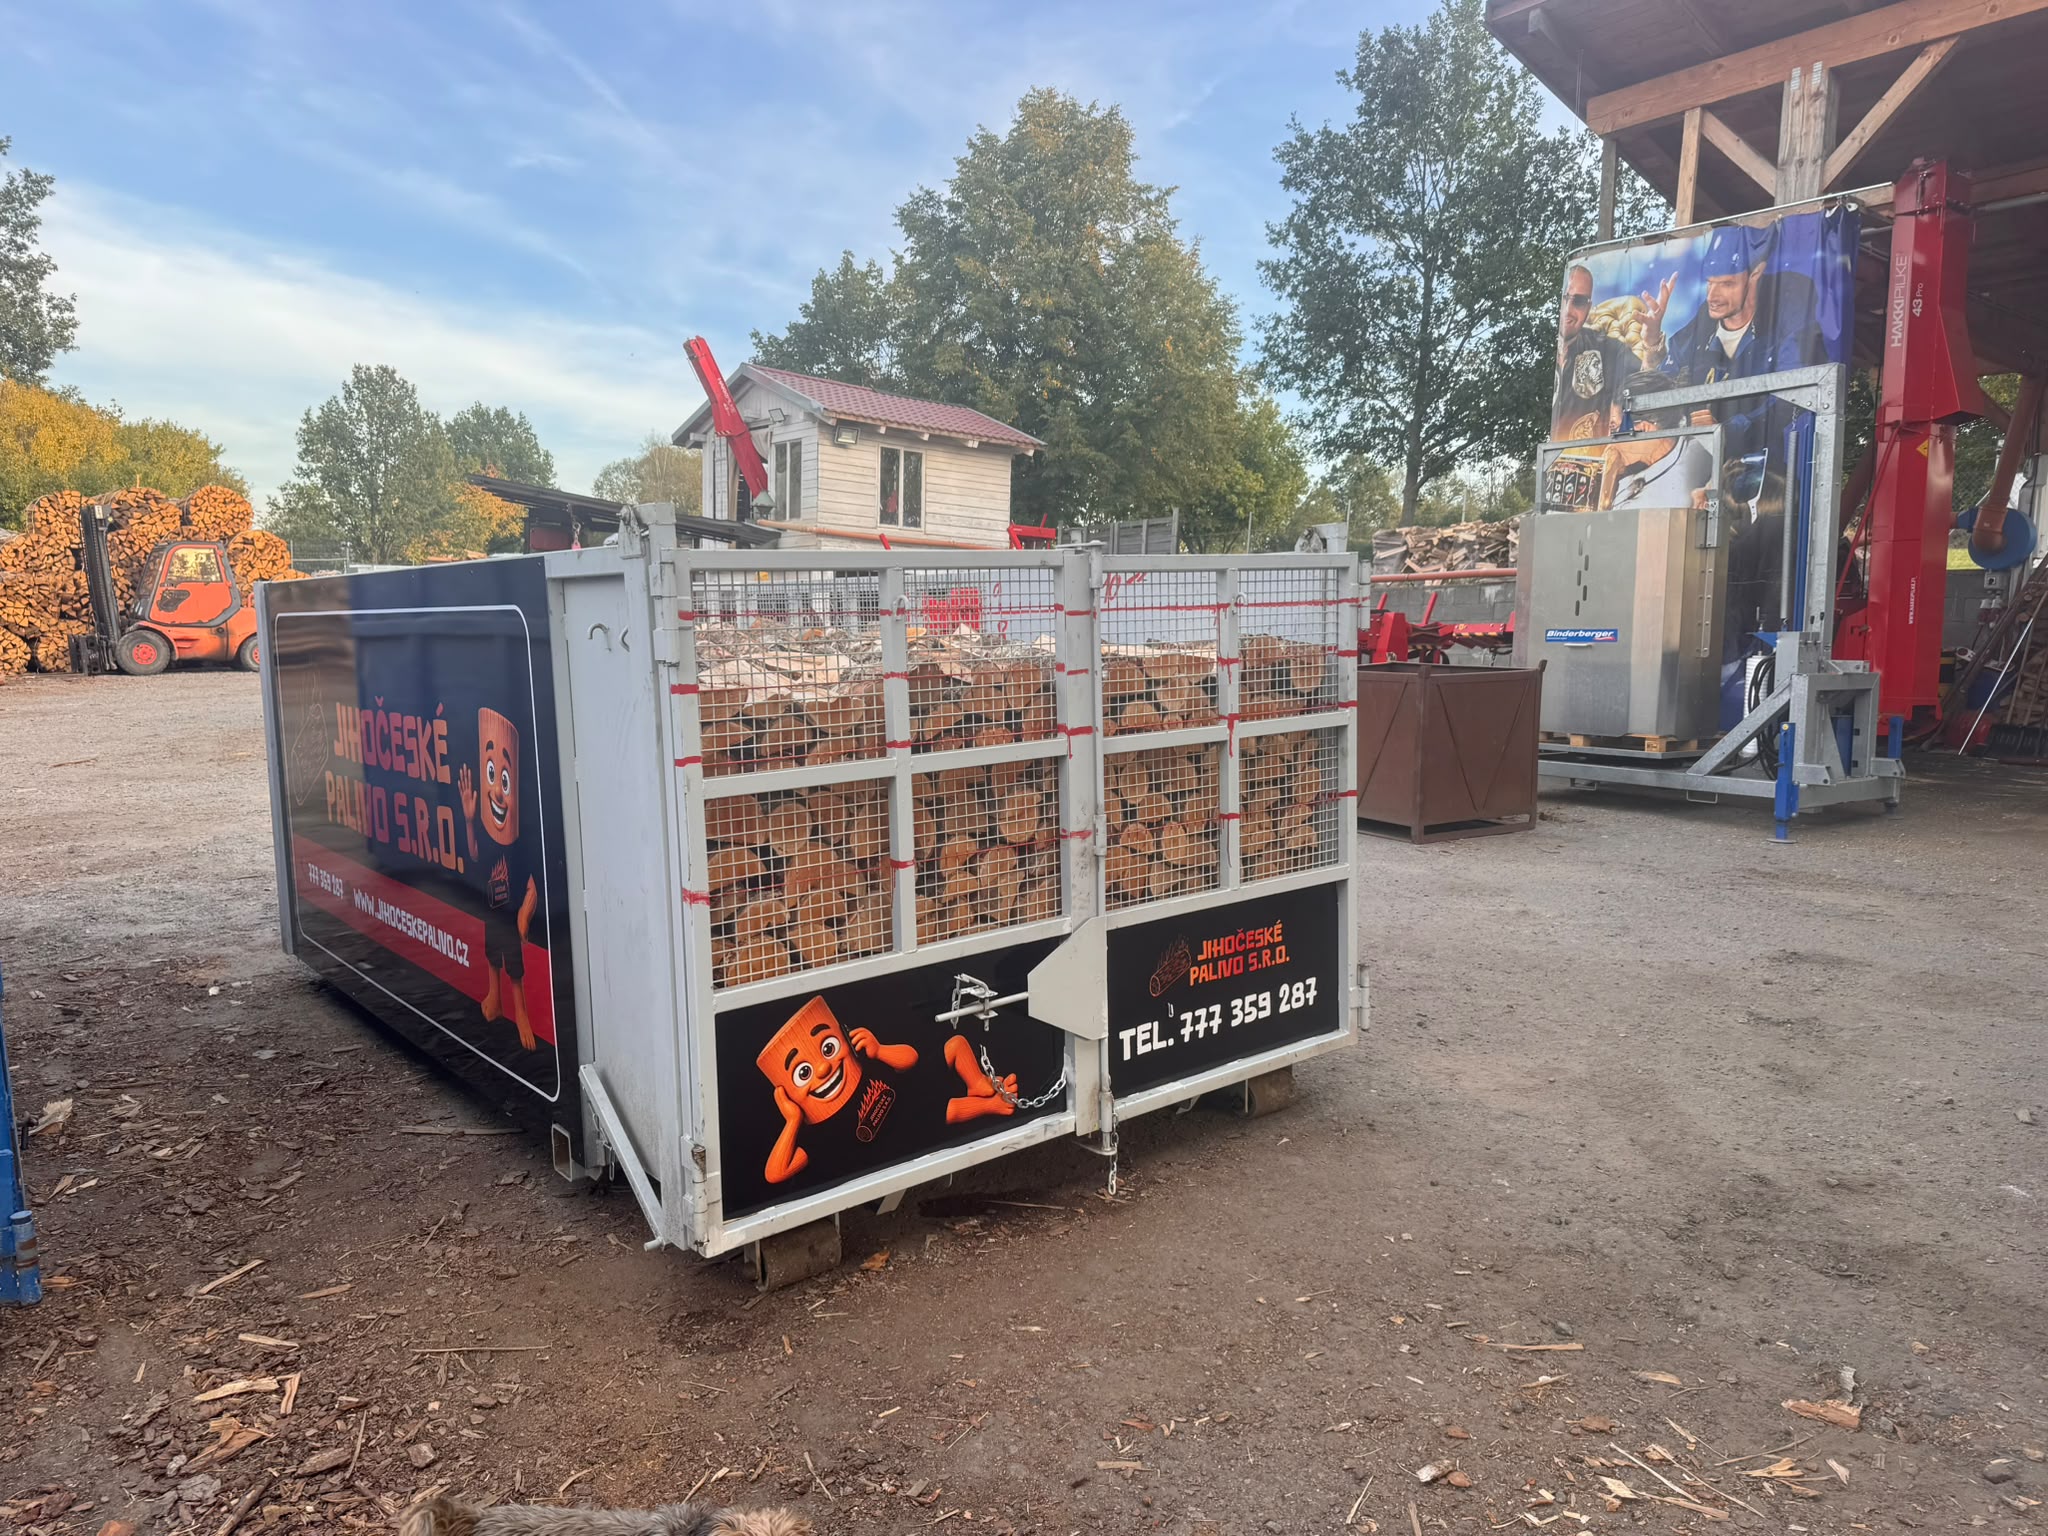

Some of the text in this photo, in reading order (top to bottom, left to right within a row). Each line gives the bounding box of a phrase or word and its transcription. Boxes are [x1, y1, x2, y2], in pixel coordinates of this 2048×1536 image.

[1891, 255, 1908, 347] HAKKIPILKE
[1912, 283, 1924, 317] 43 Pro
[1546, 630, 1614, 638] Binderberger
[334, 695, 451, 785] JIHOČESKÉ
[325, 770, 465, 874] PALIVO S.R.O.
[308, 862, 319, 887] 777
[320, 869, 331, 892] 359
[1197, 919, 1283, 961] JIHOČESKÉ
[1189, 945, 1290, 986] PALIVO S.R.O.
[1119, 976, 1318, 1061] TEL. 777 359 287
